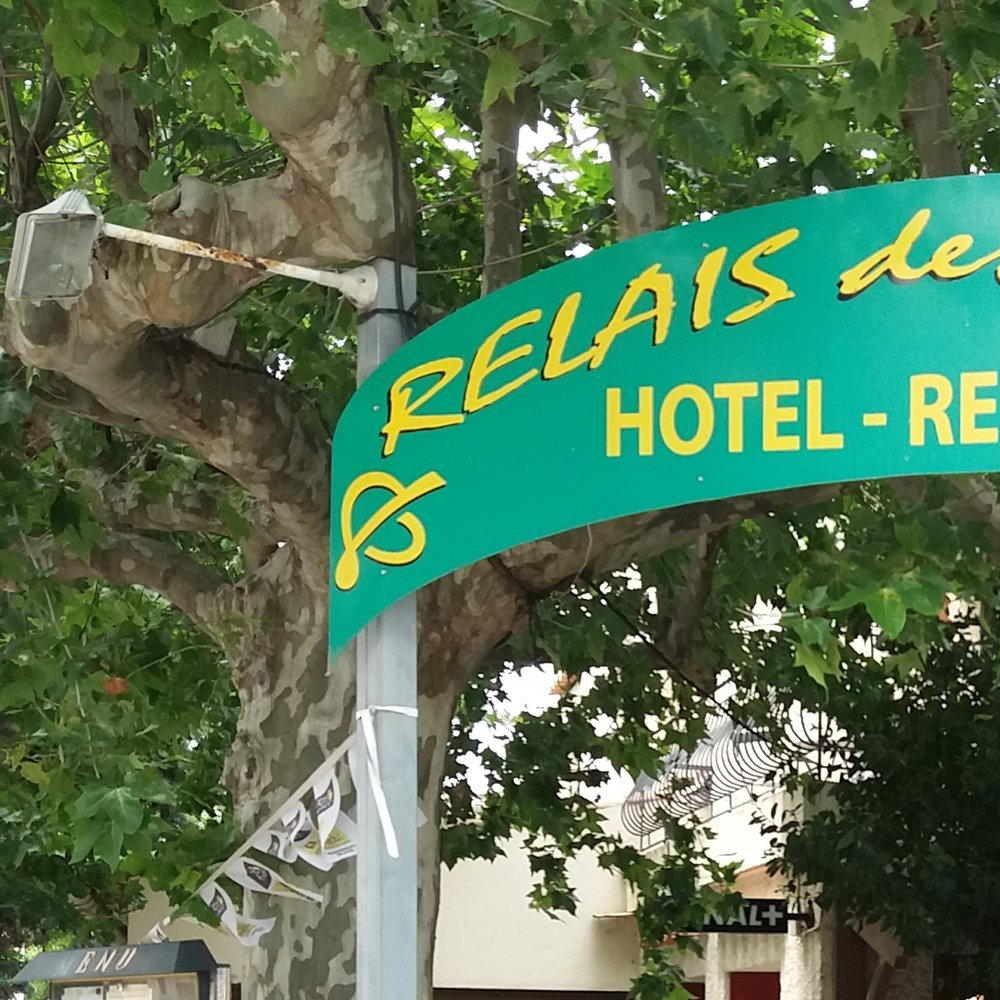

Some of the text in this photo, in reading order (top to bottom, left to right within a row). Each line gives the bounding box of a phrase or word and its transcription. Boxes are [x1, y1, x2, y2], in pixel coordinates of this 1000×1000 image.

[380, 226, 801, 458] RELAIS
[605, 378, 845, 458] HOTEL
[703, 904, 784, 927] NAL+
